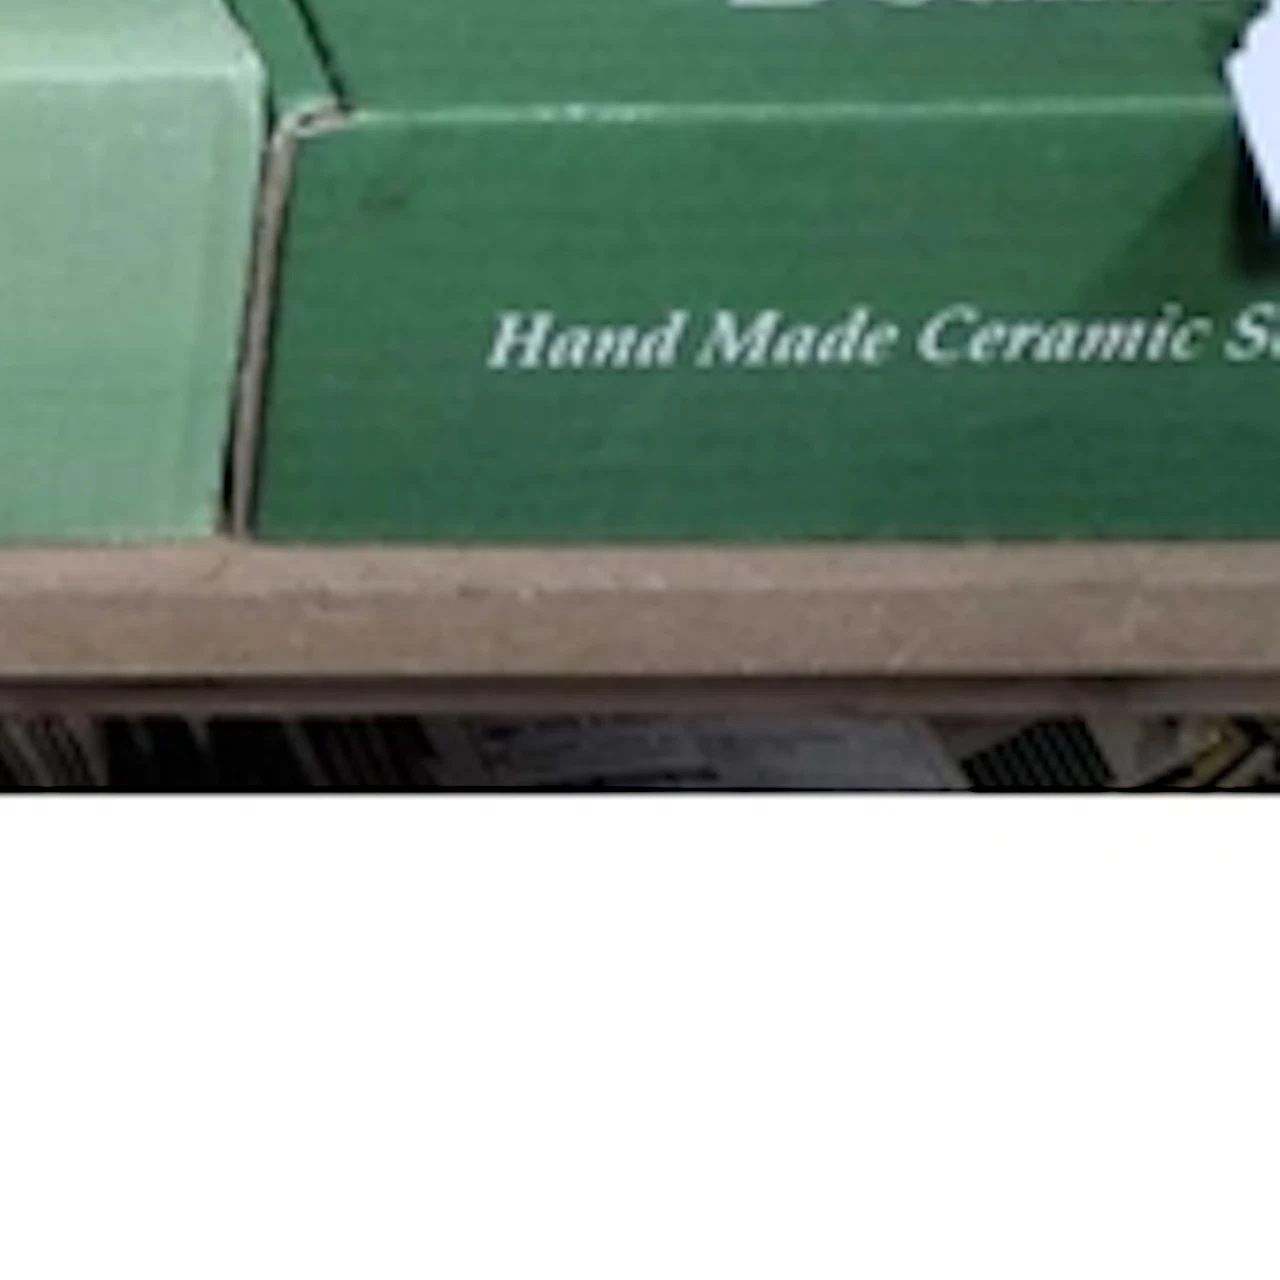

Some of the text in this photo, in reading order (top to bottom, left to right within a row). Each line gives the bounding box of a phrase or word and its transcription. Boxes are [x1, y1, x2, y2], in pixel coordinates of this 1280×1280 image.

[488, 301, 1280, 369] Hand Made Ceramic S
